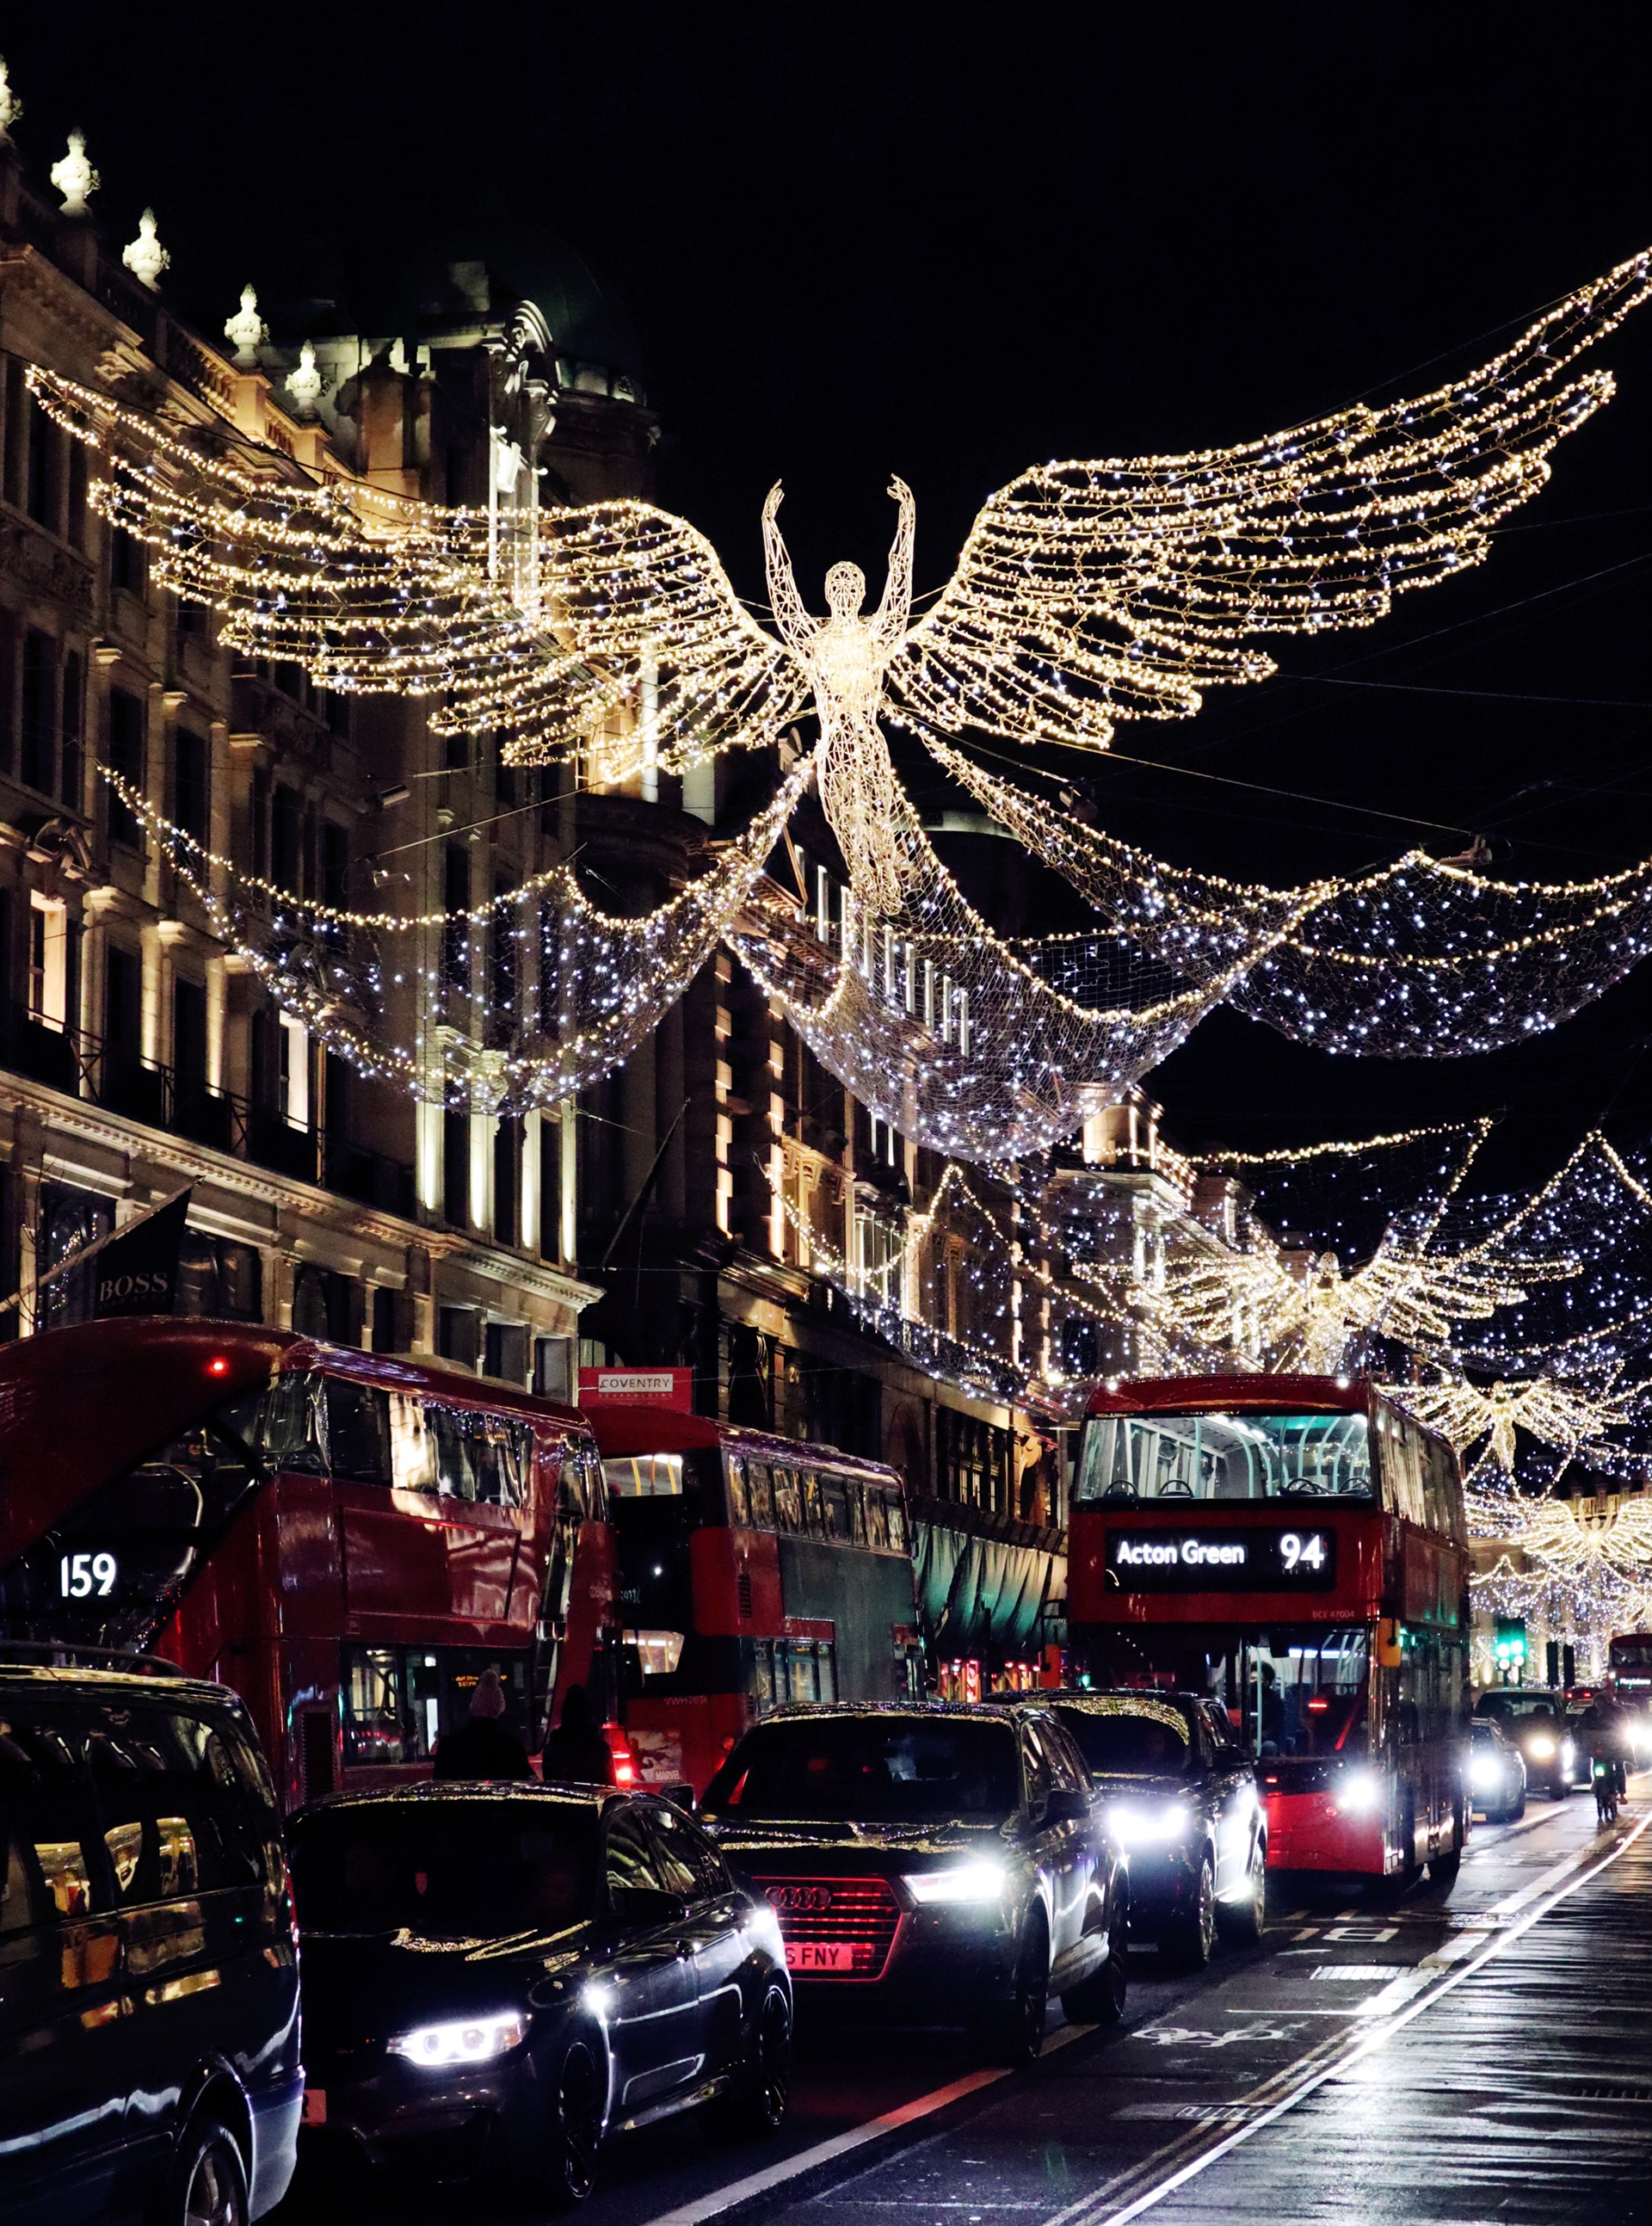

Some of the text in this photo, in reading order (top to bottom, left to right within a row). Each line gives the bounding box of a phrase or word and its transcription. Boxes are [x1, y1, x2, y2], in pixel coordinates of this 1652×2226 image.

[99, 1272, 169, 1303] BOSS
[601, 1378, 670, 1388] COVENTRY
[1116, 1533, 1325, 1569] Acton Green 94
[60, 1552, 116, 1597] 159
[1312, 1610, 1328, 1619] BCE
[802, 1947, 839, 1965] FNY
